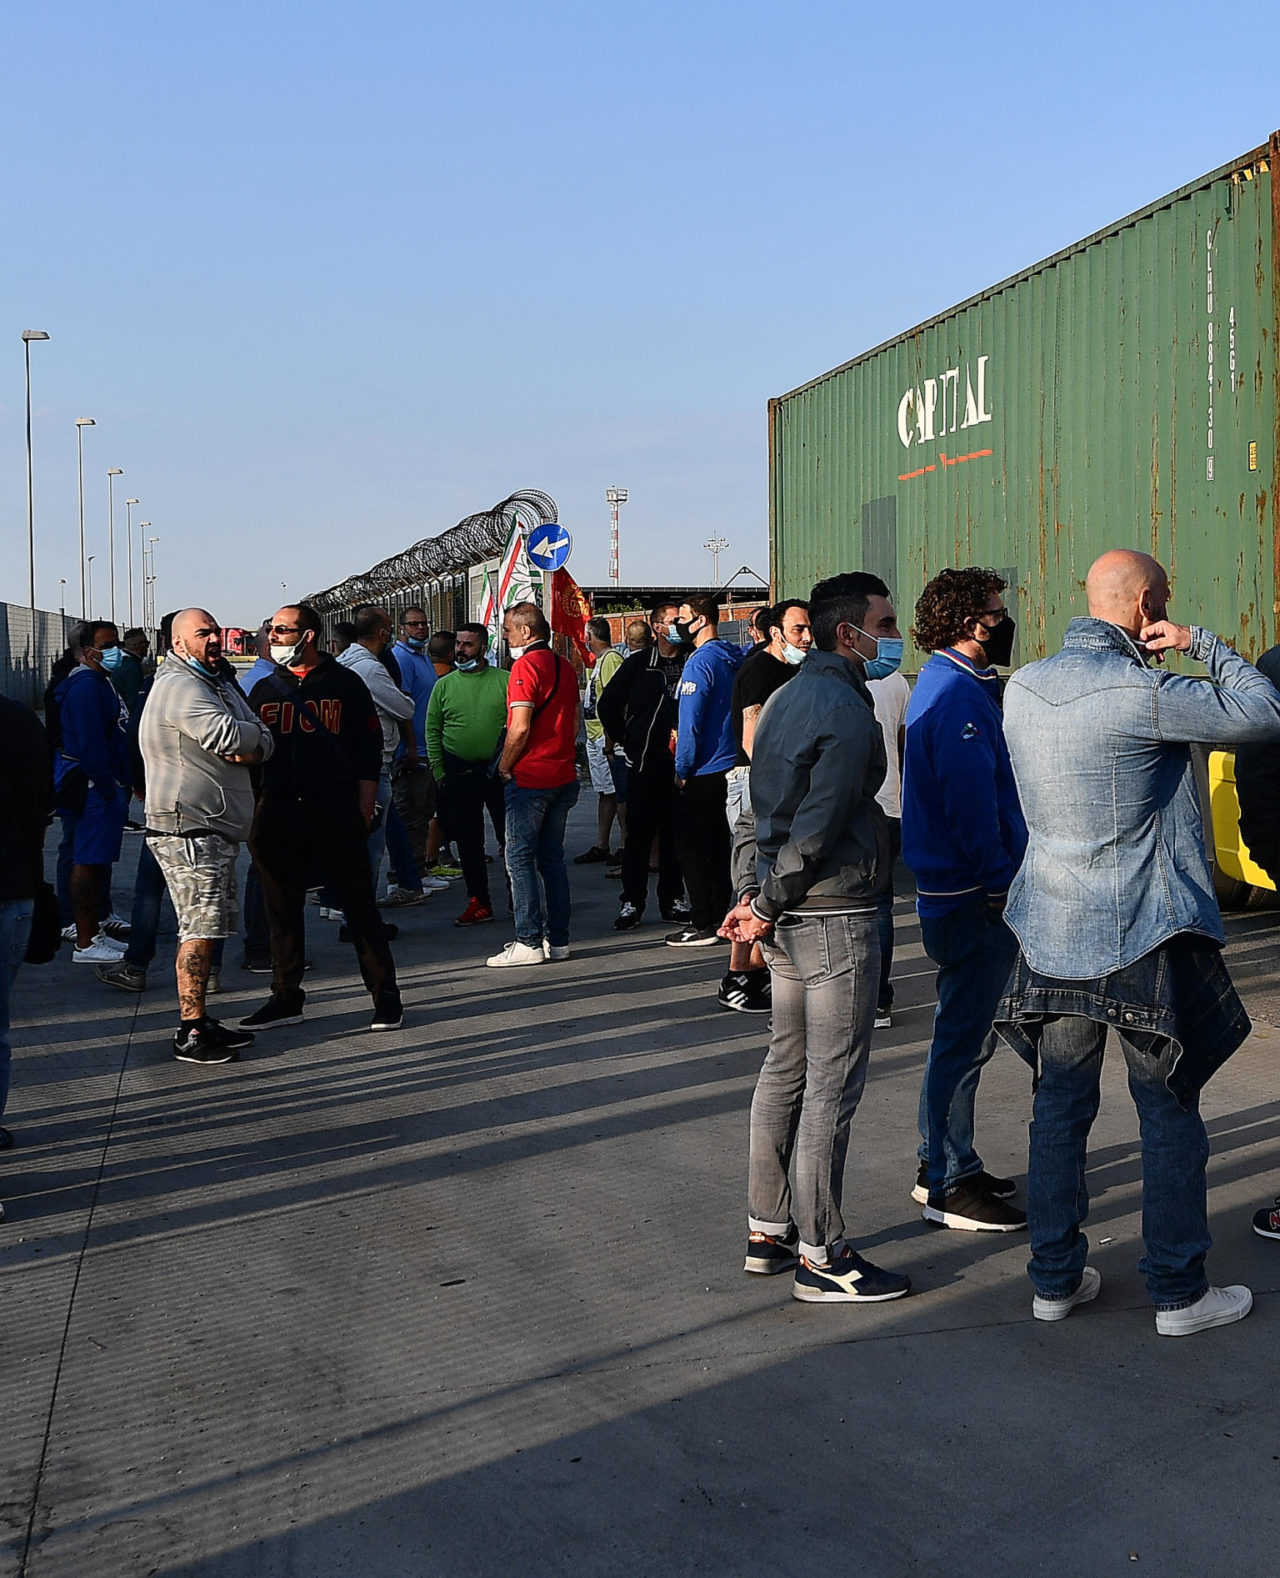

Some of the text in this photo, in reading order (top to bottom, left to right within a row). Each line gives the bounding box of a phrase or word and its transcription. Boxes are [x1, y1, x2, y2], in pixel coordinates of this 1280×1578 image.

[1228, 306, 1236, 393] 45G1
[897, 355, 992, 449] CAPITAL
[261, 699, 342, 734] FIOM
